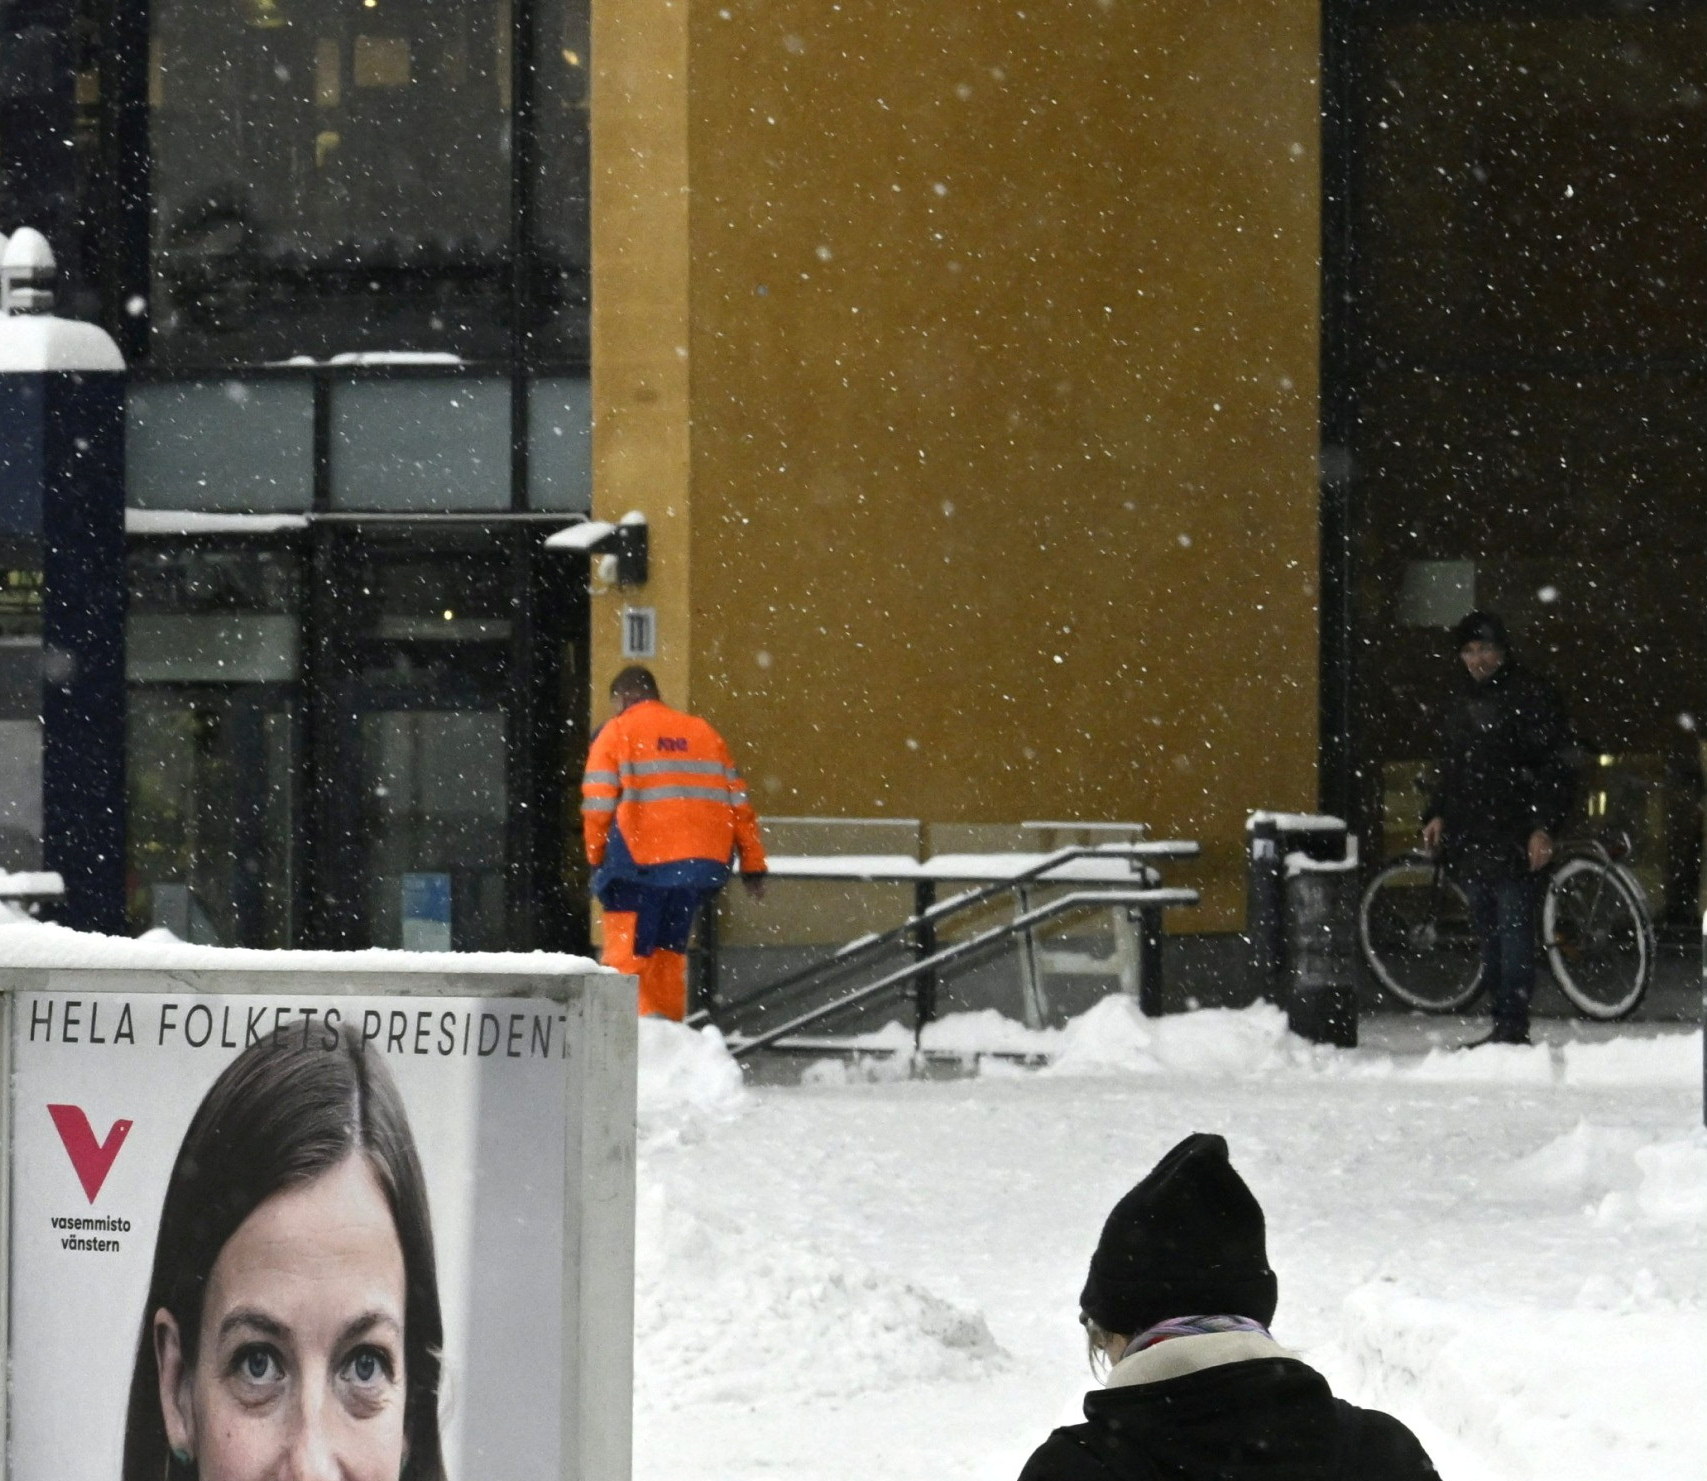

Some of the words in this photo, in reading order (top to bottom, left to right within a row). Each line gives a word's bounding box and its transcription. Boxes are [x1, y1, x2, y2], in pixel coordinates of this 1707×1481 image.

[30, 1000, 135, 1045] HELA
[158, 1004, 342, 1052] FOLKETS
[51, 1215, 131, 1232] vasemmisto
[61, 1234, 120, 1252] vänstern
